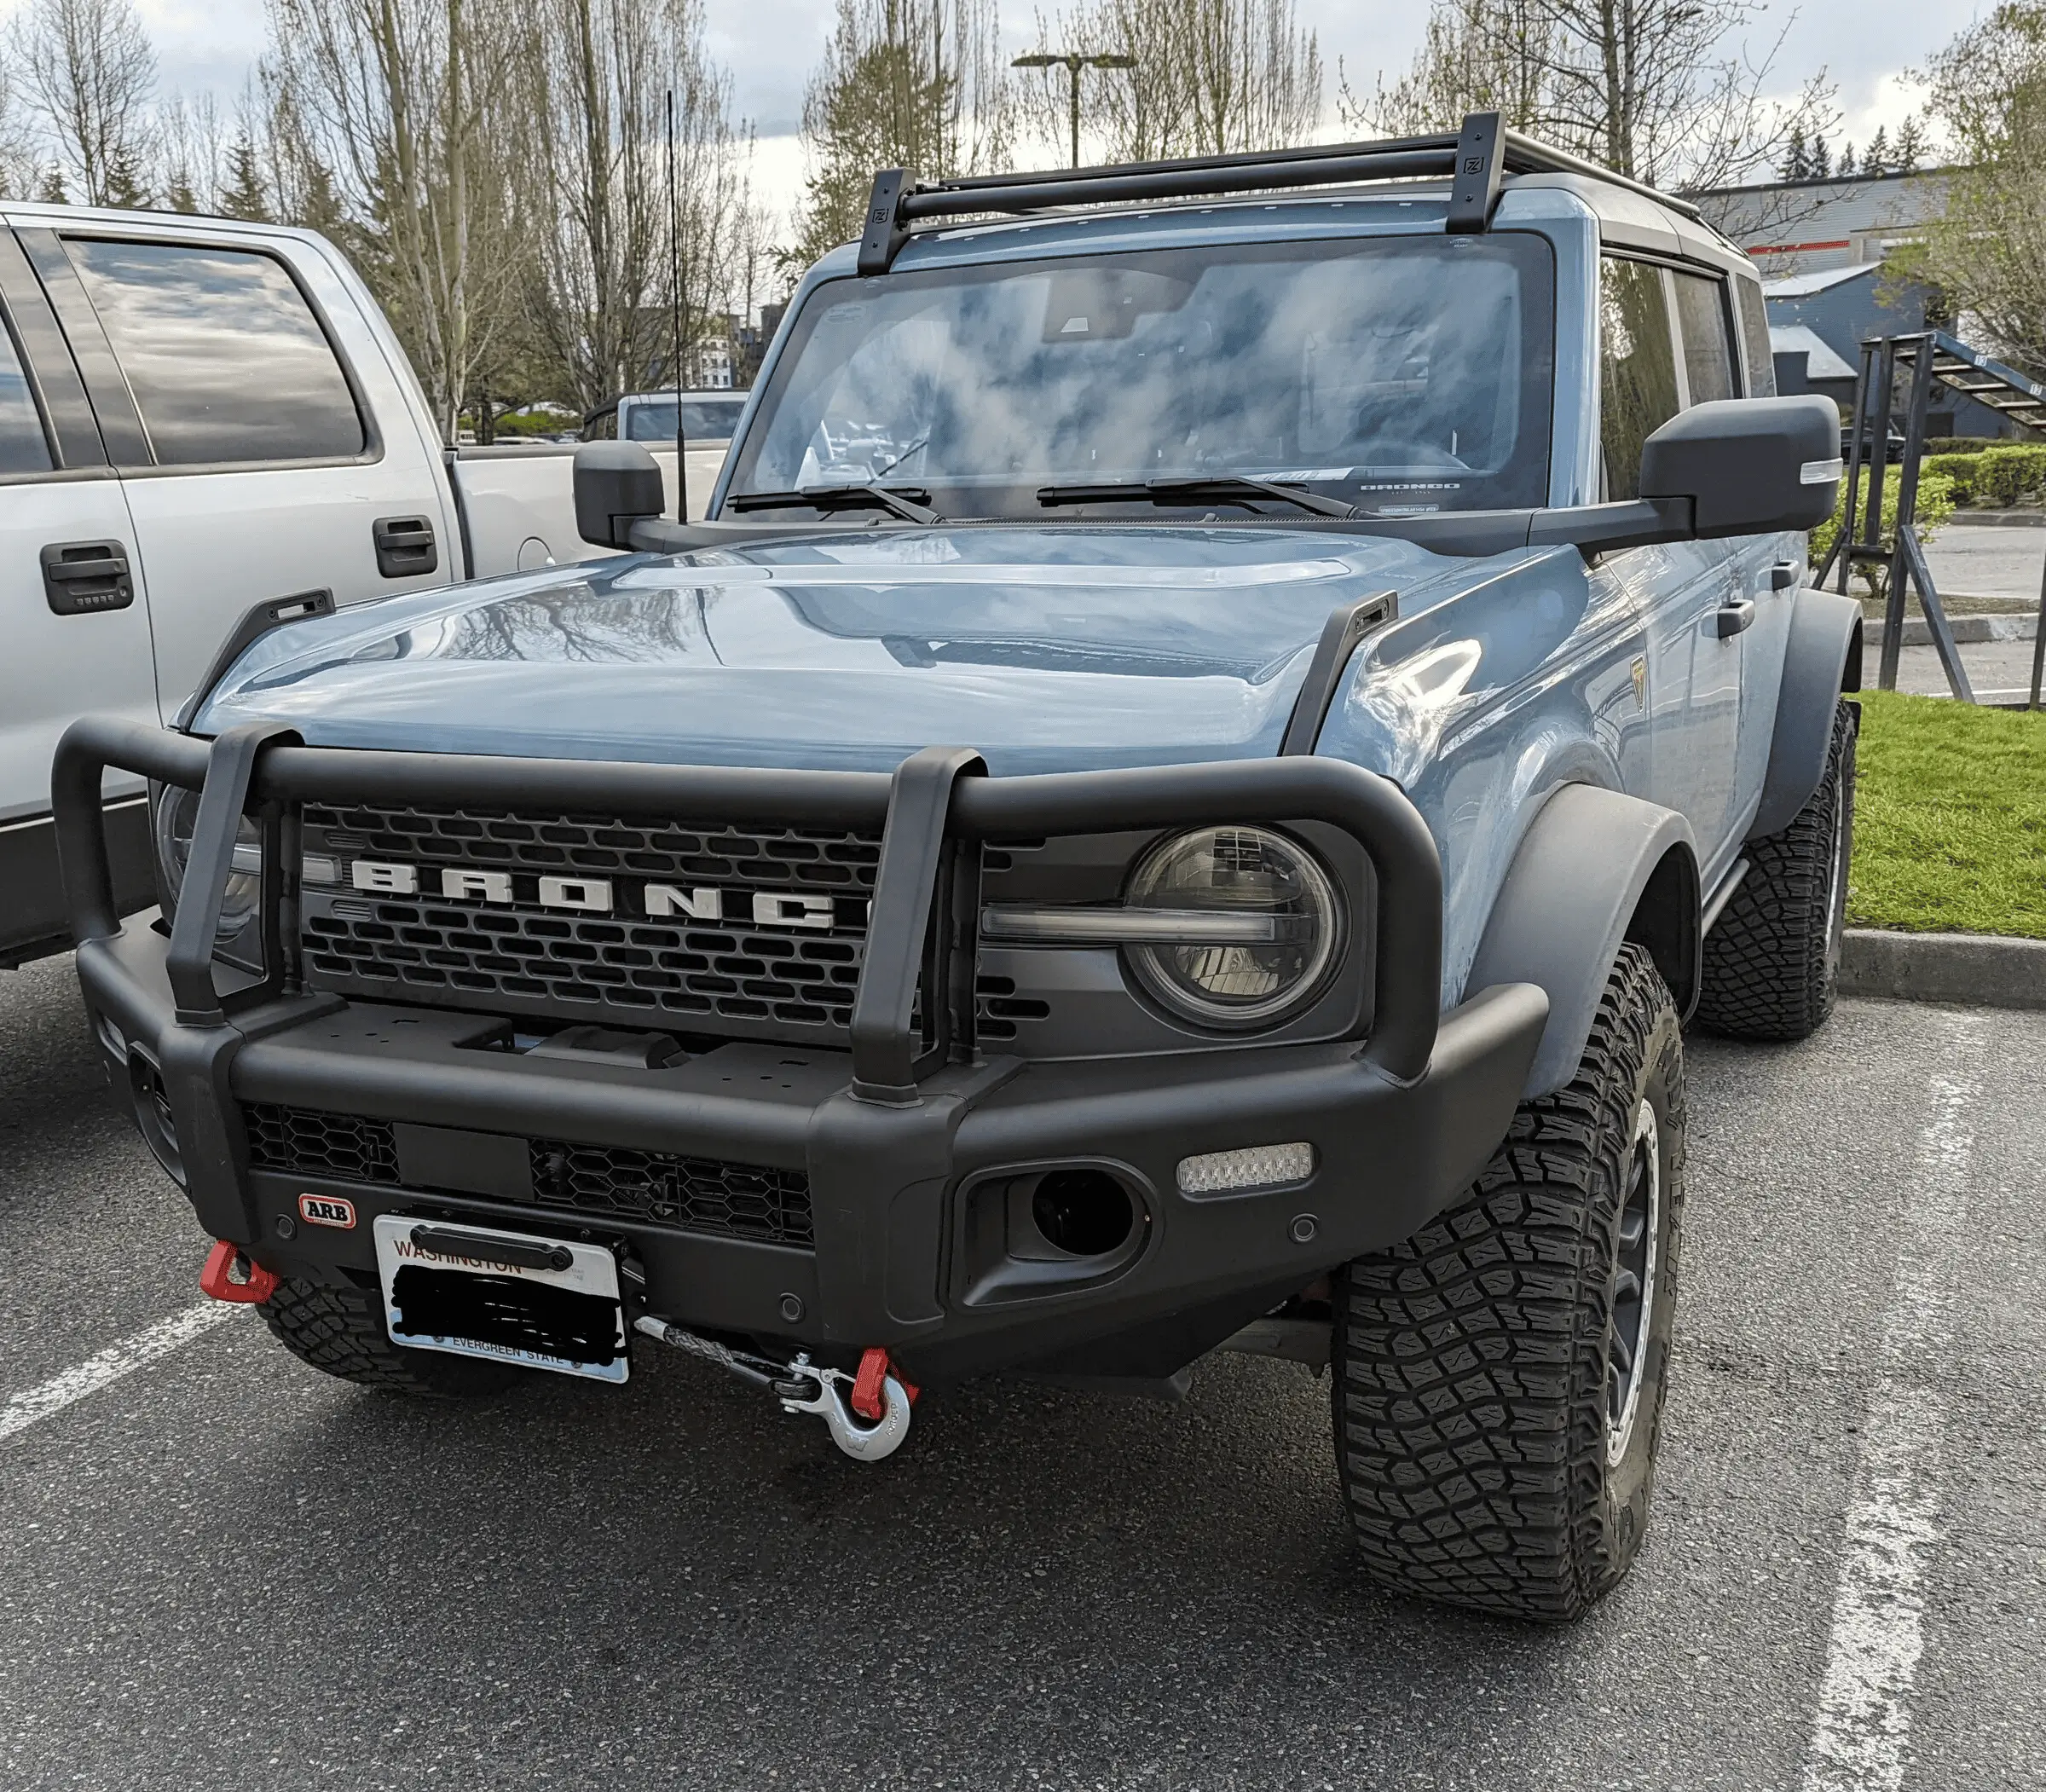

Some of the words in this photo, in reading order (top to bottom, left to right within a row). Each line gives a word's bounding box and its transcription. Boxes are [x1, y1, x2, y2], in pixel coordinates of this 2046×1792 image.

[352, 859, 873, 928] BRONC
[308, 1201, 348, 1221] ARB
[453, 1337, 521, 1357] EVERGREEN
[886, 1403, 899, 1436] FORGED
